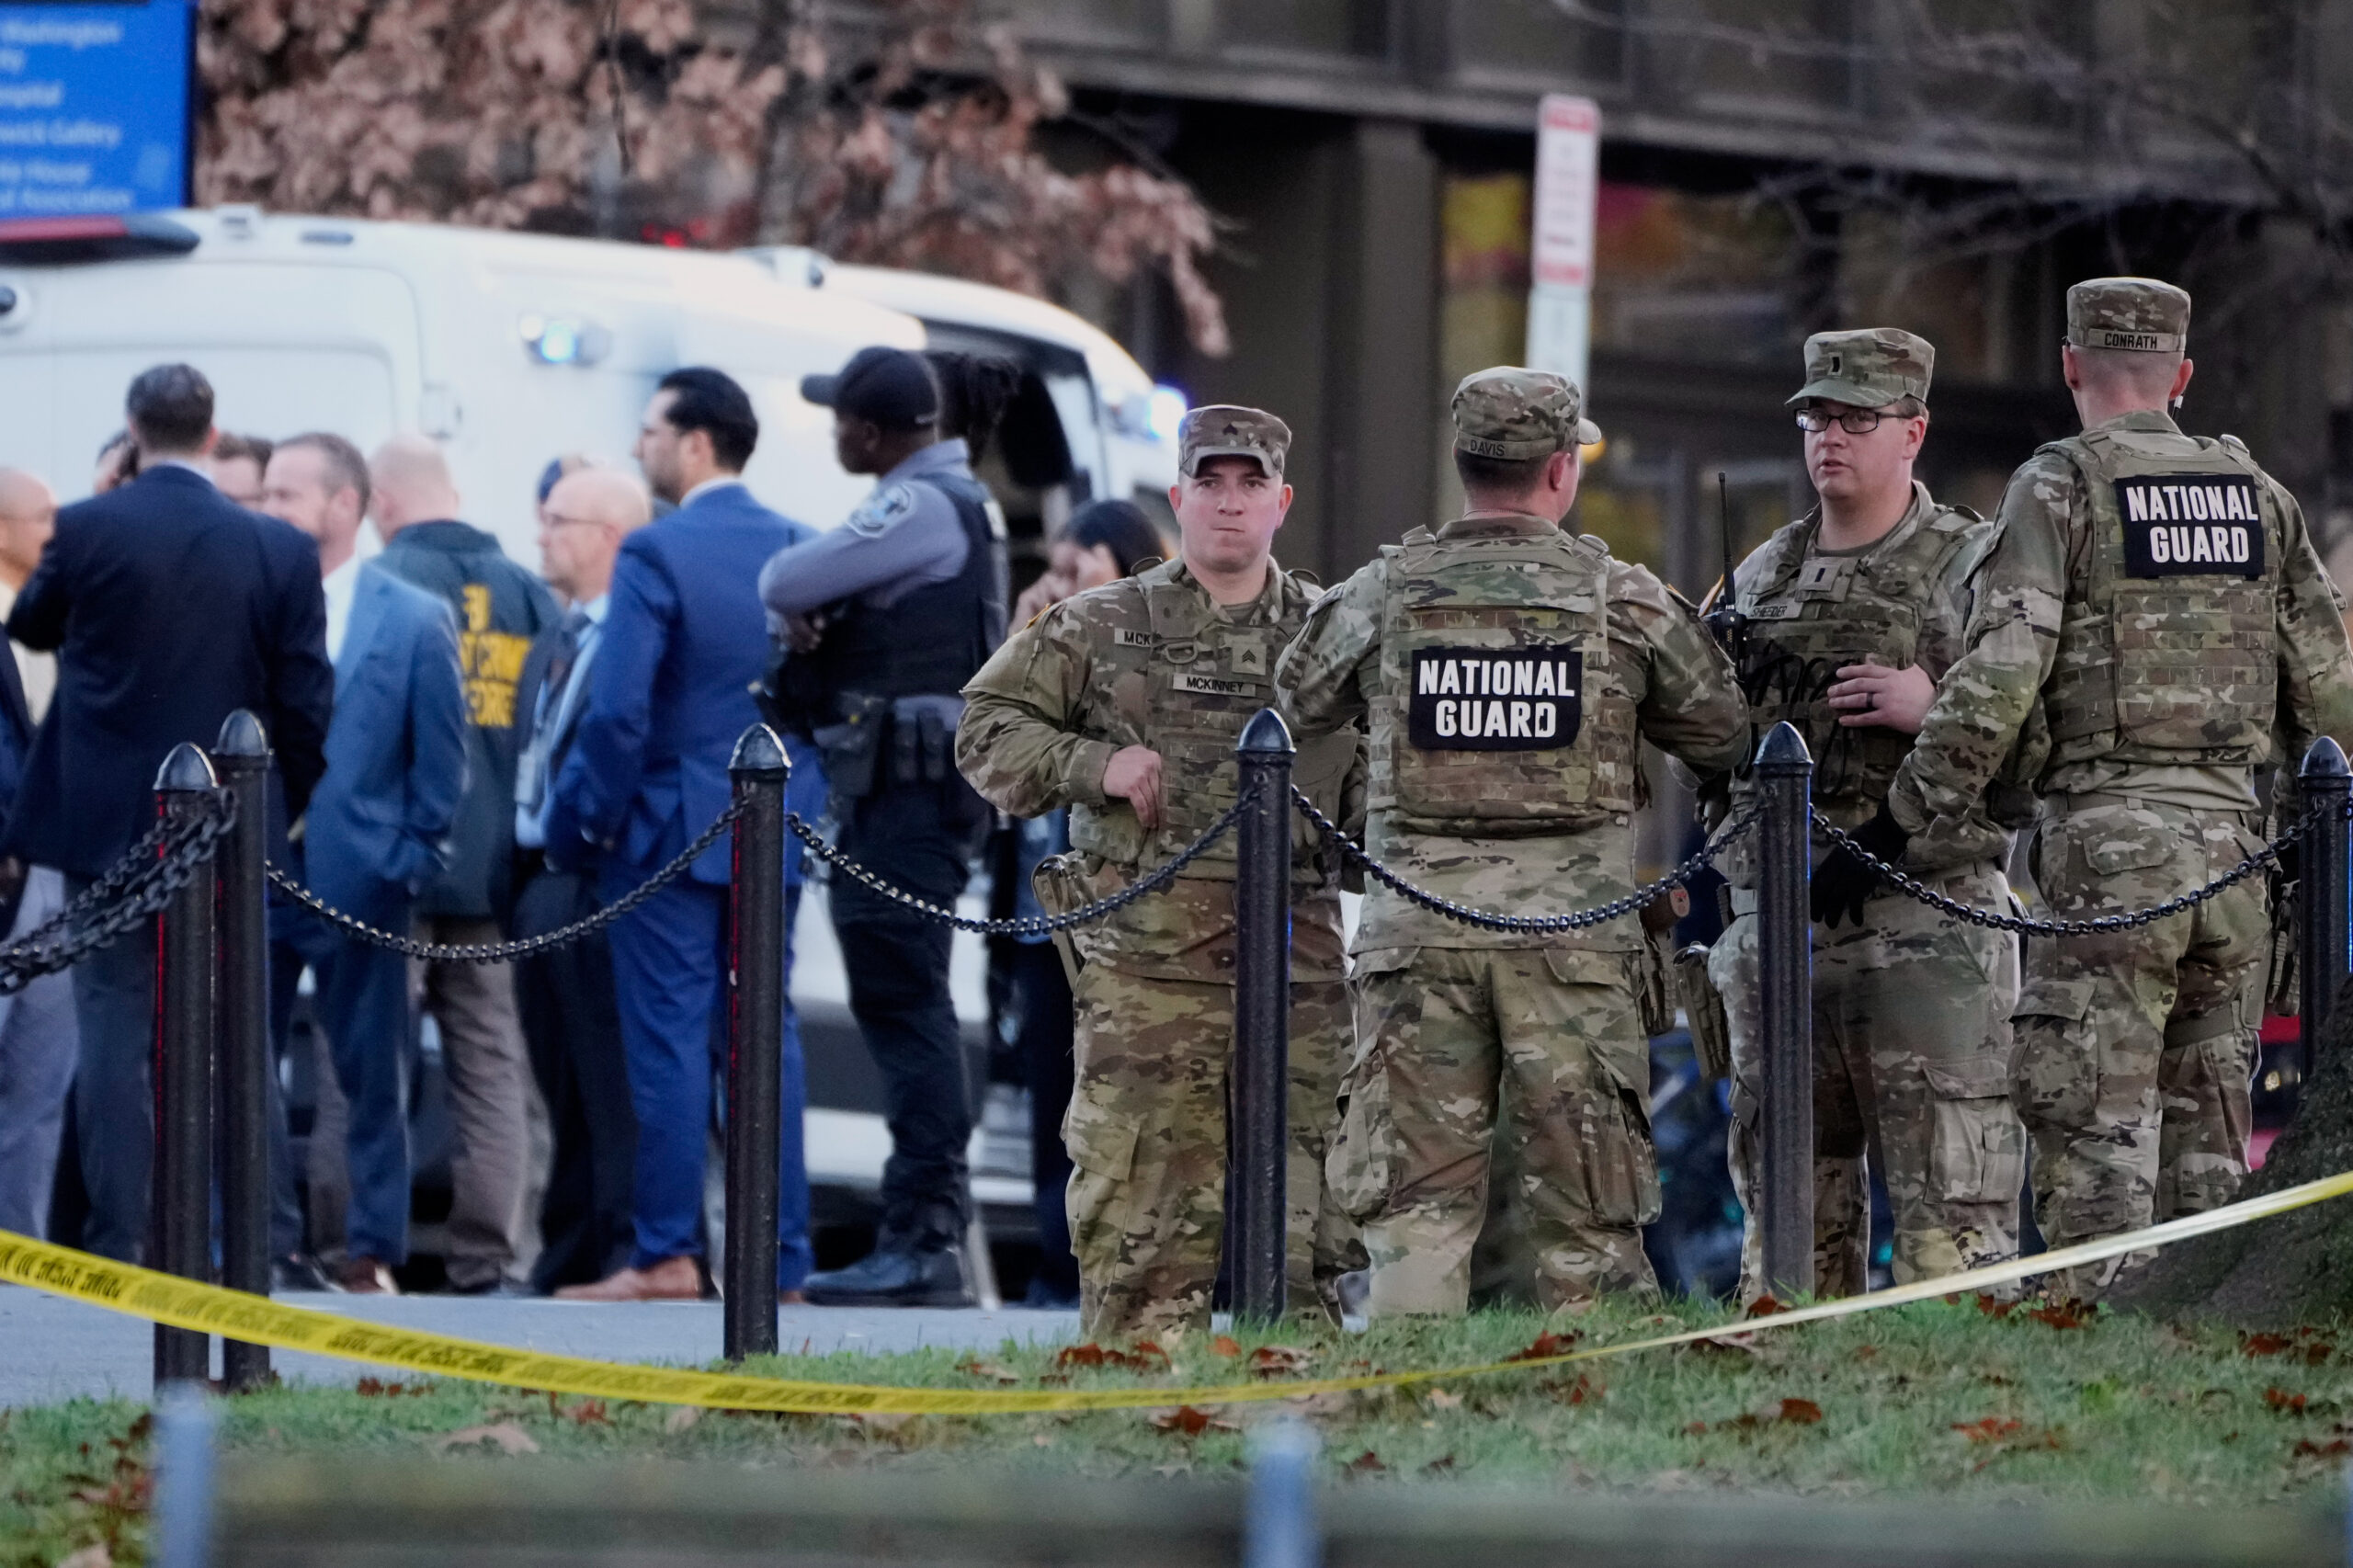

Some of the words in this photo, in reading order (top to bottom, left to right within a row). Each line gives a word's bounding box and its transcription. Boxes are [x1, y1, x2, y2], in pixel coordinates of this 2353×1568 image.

[2104, 332, 2158, 350] CONRATH
[1470, 439, 1506, 457] DAVIS
[2126, 484, 2258, 521] NATIONAL
[2149, 526, 2250, 563] GUARD
[1124, 631, 1151, 645] MCK
[1187, 676, 1245, 693] MCKINNEY
[1418, 659, 1575, 697] NATIONAL
[1435, 699, 1557, 738] GUARD
